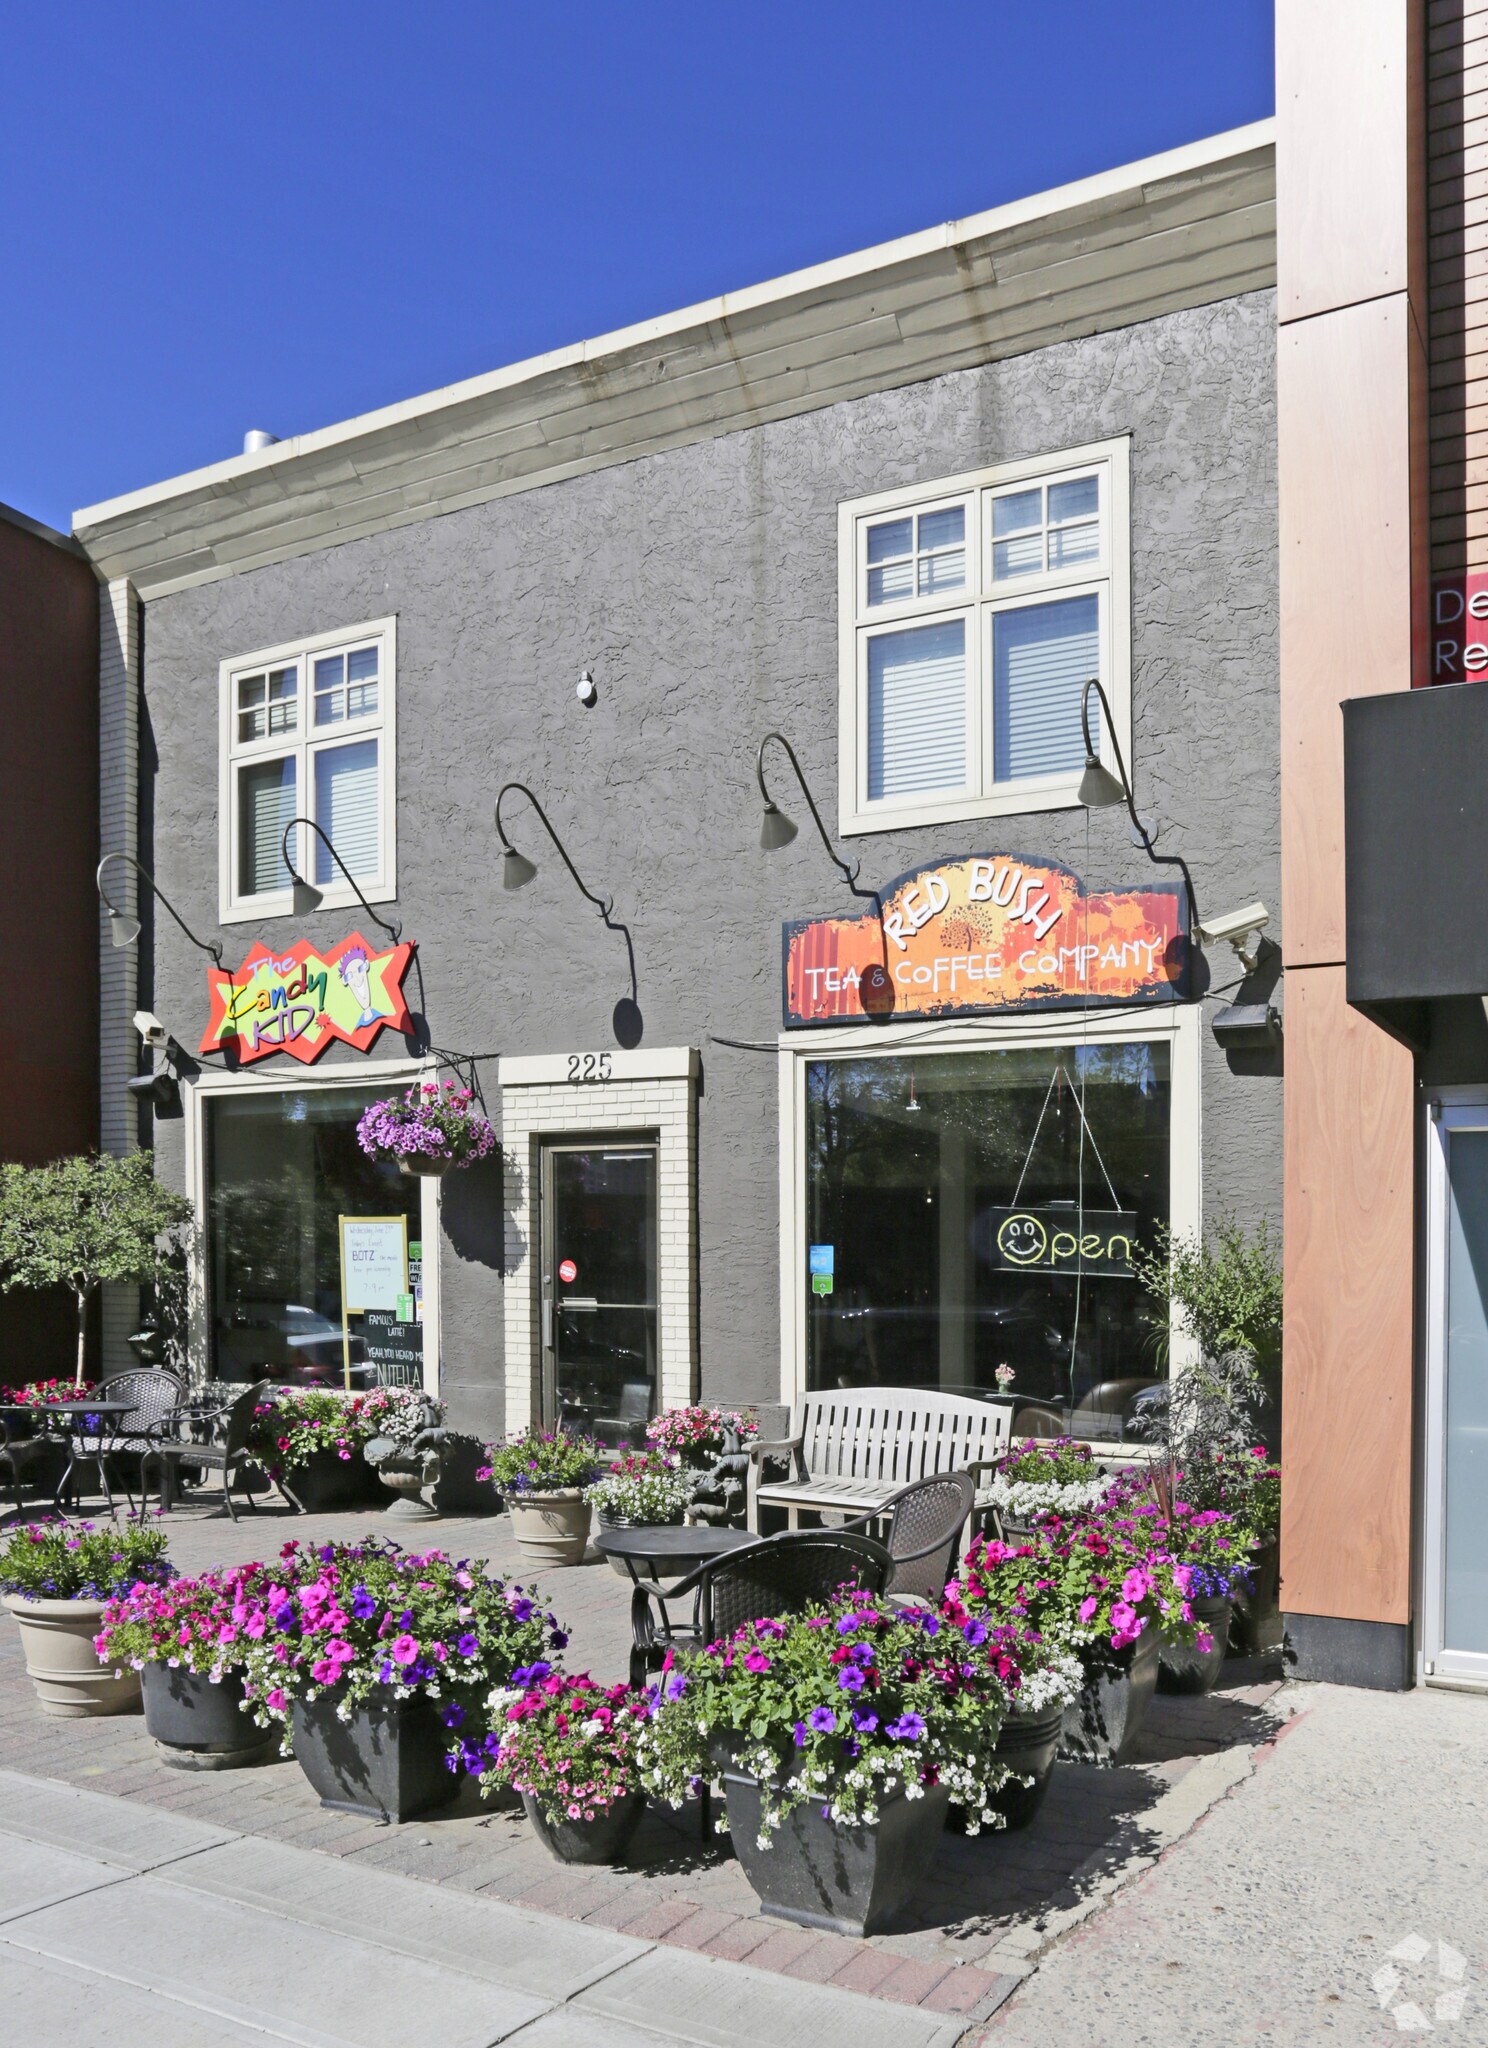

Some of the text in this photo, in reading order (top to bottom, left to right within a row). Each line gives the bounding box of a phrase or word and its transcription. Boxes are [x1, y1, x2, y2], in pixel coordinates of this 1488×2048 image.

[883, 858, 1063, 951] RED BUSH
[246, 955, 297, 983] The
[804, 936, 1163, 1000] TEA & COFFEE COMPANY
[225, 962, 327, 1021] Candy
[252, 1004, 316, 1051] KID
[567, 1052, 612, 1083] 225
[410, 1264, 422, 1272] FRE
[368, 1314, 394, 1326] FAMOUS
[376, 1362, 422, 1388] NUTELLA
